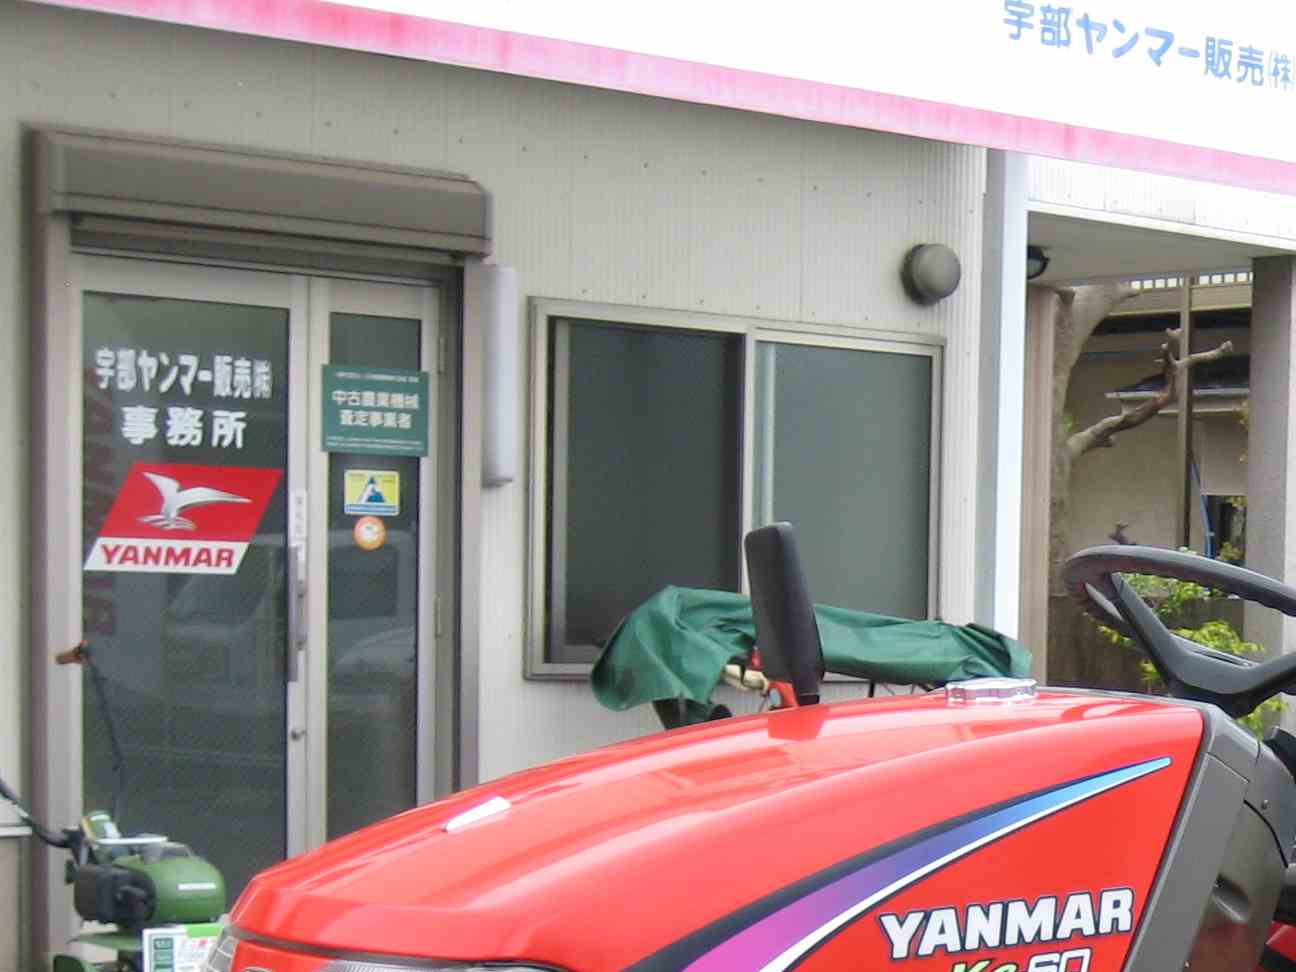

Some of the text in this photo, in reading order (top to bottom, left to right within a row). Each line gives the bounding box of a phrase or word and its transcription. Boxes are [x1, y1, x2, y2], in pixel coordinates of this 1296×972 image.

[121, 405, 247, 449] 事務所
[101, 544, 234, 568] YANMAR
[880, 888, 1134, 960] YANMAR
